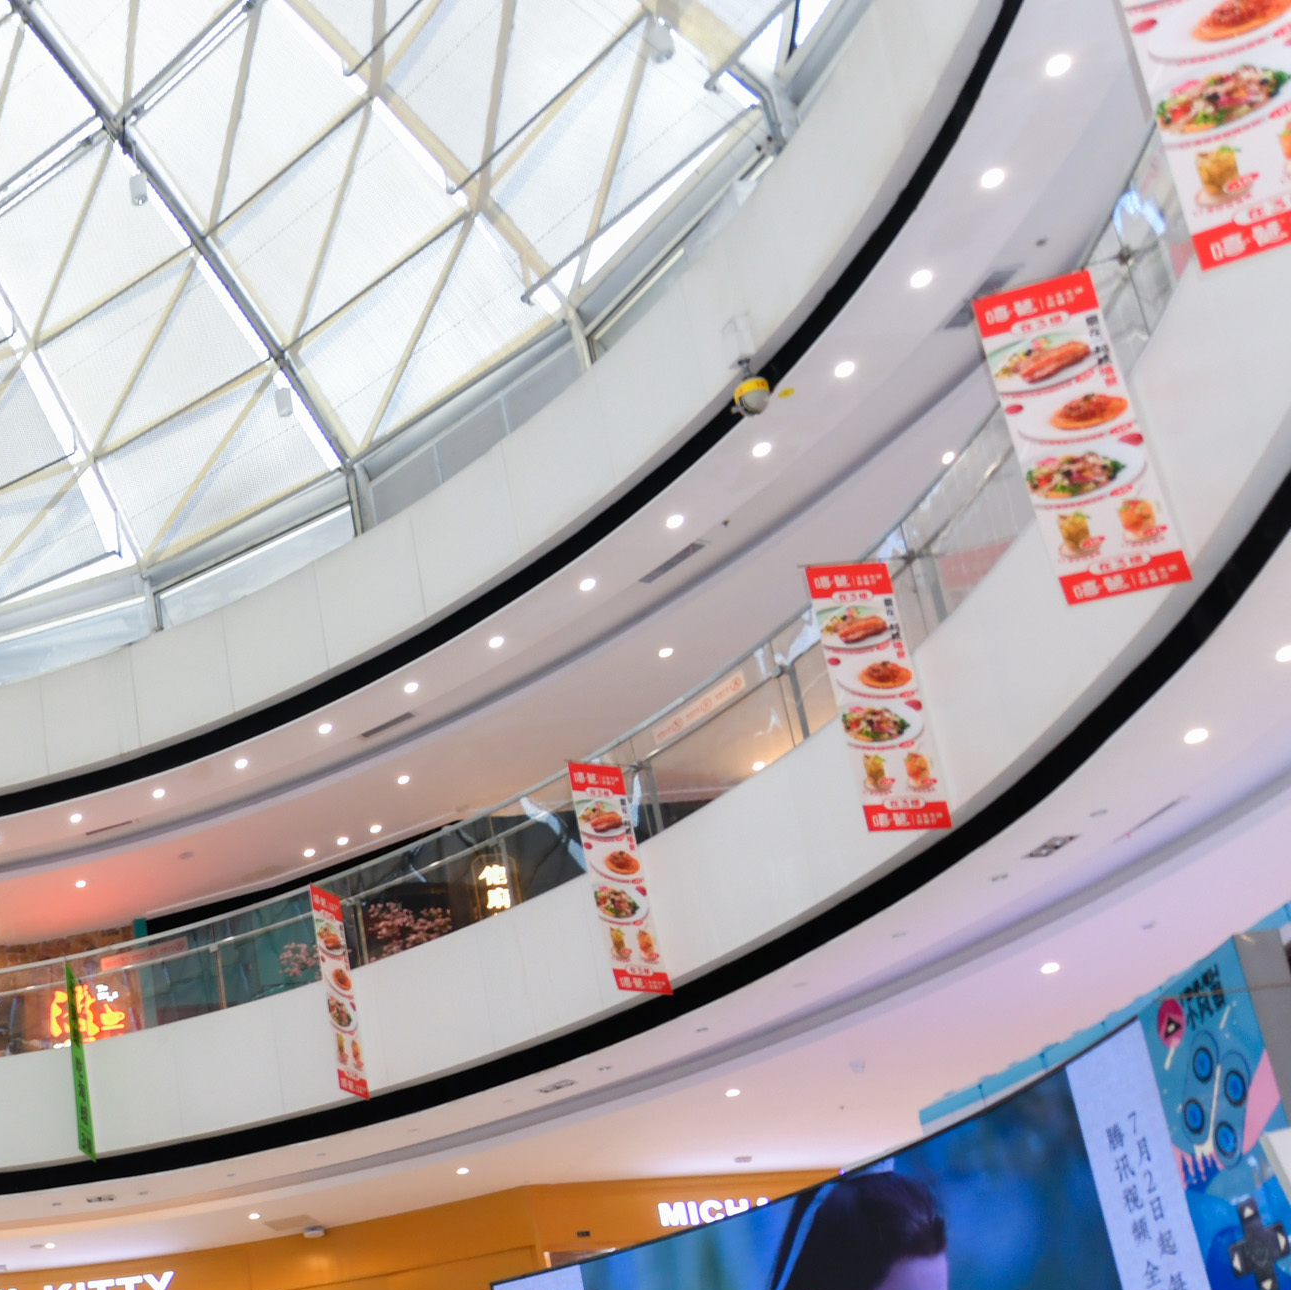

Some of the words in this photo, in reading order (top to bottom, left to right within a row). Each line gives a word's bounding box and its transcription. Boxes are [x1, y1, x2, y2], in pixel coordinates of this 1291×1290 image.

[657, 1197, 769, 1228] MICH
[1105, 1124, 1152, 1246] 腾讯视频
[1127, 1111, 1178, 1256] 7月2日起
